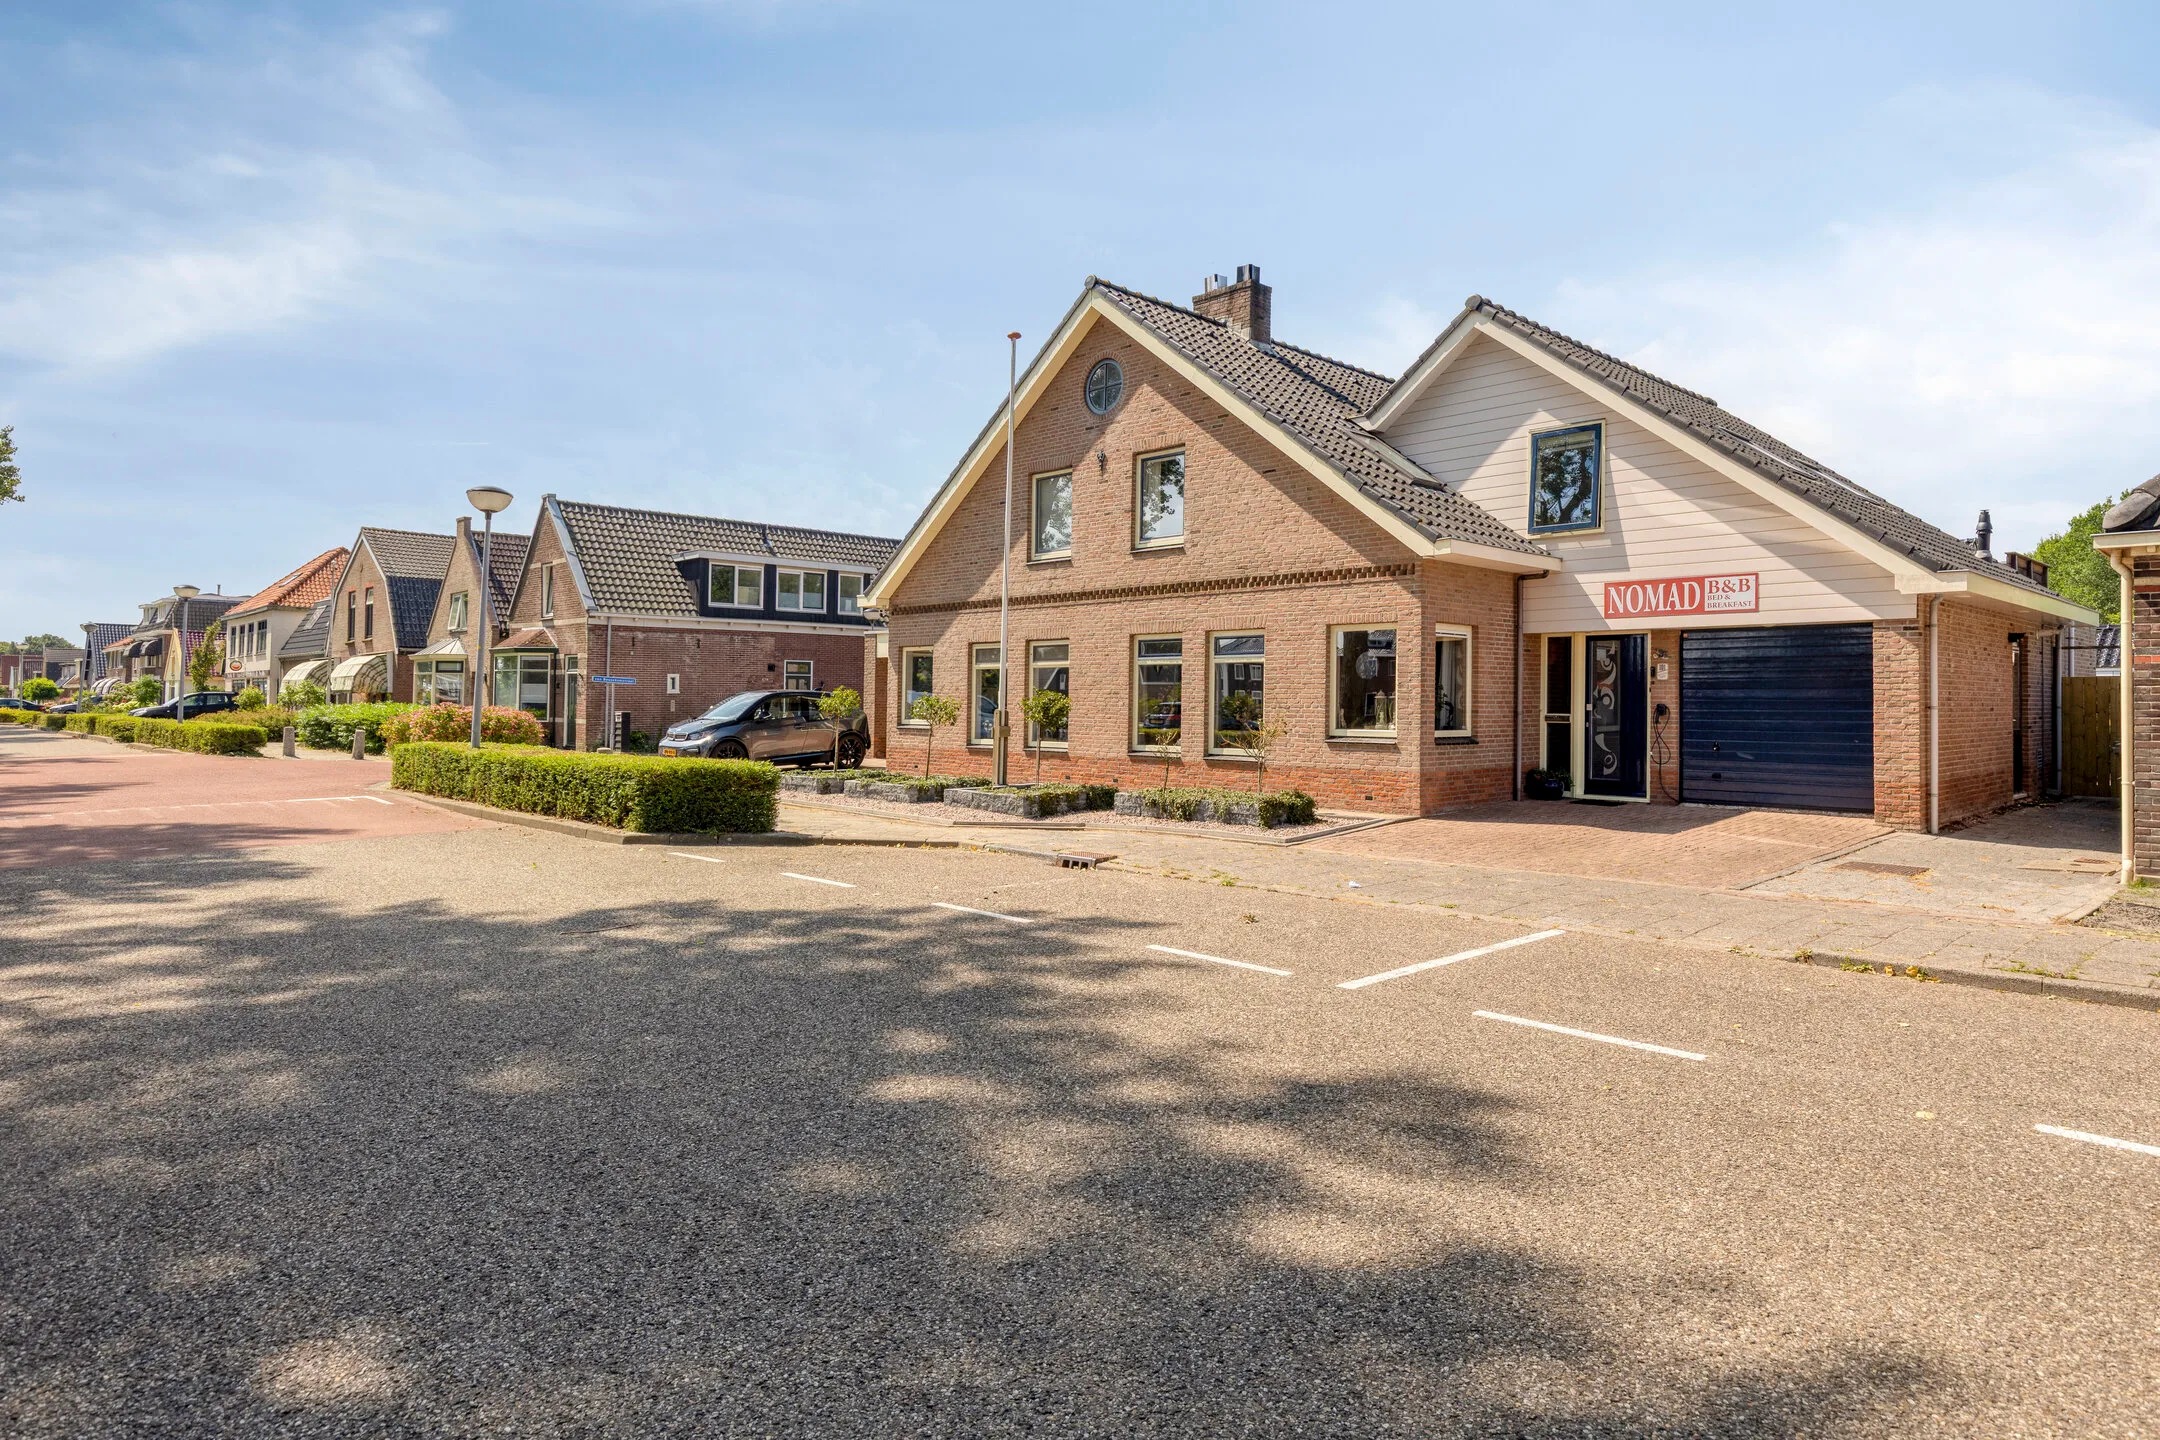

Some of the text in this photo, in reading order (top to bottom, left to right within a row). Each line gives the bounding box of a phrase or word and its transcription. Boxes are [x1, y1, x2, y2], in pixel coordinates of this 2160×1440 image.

[1707, 578, 1751, 594] B&B
[1607, 581, 1701, 614] NOMAD
[1707, 601, 1752, 609] BREAKFAST
